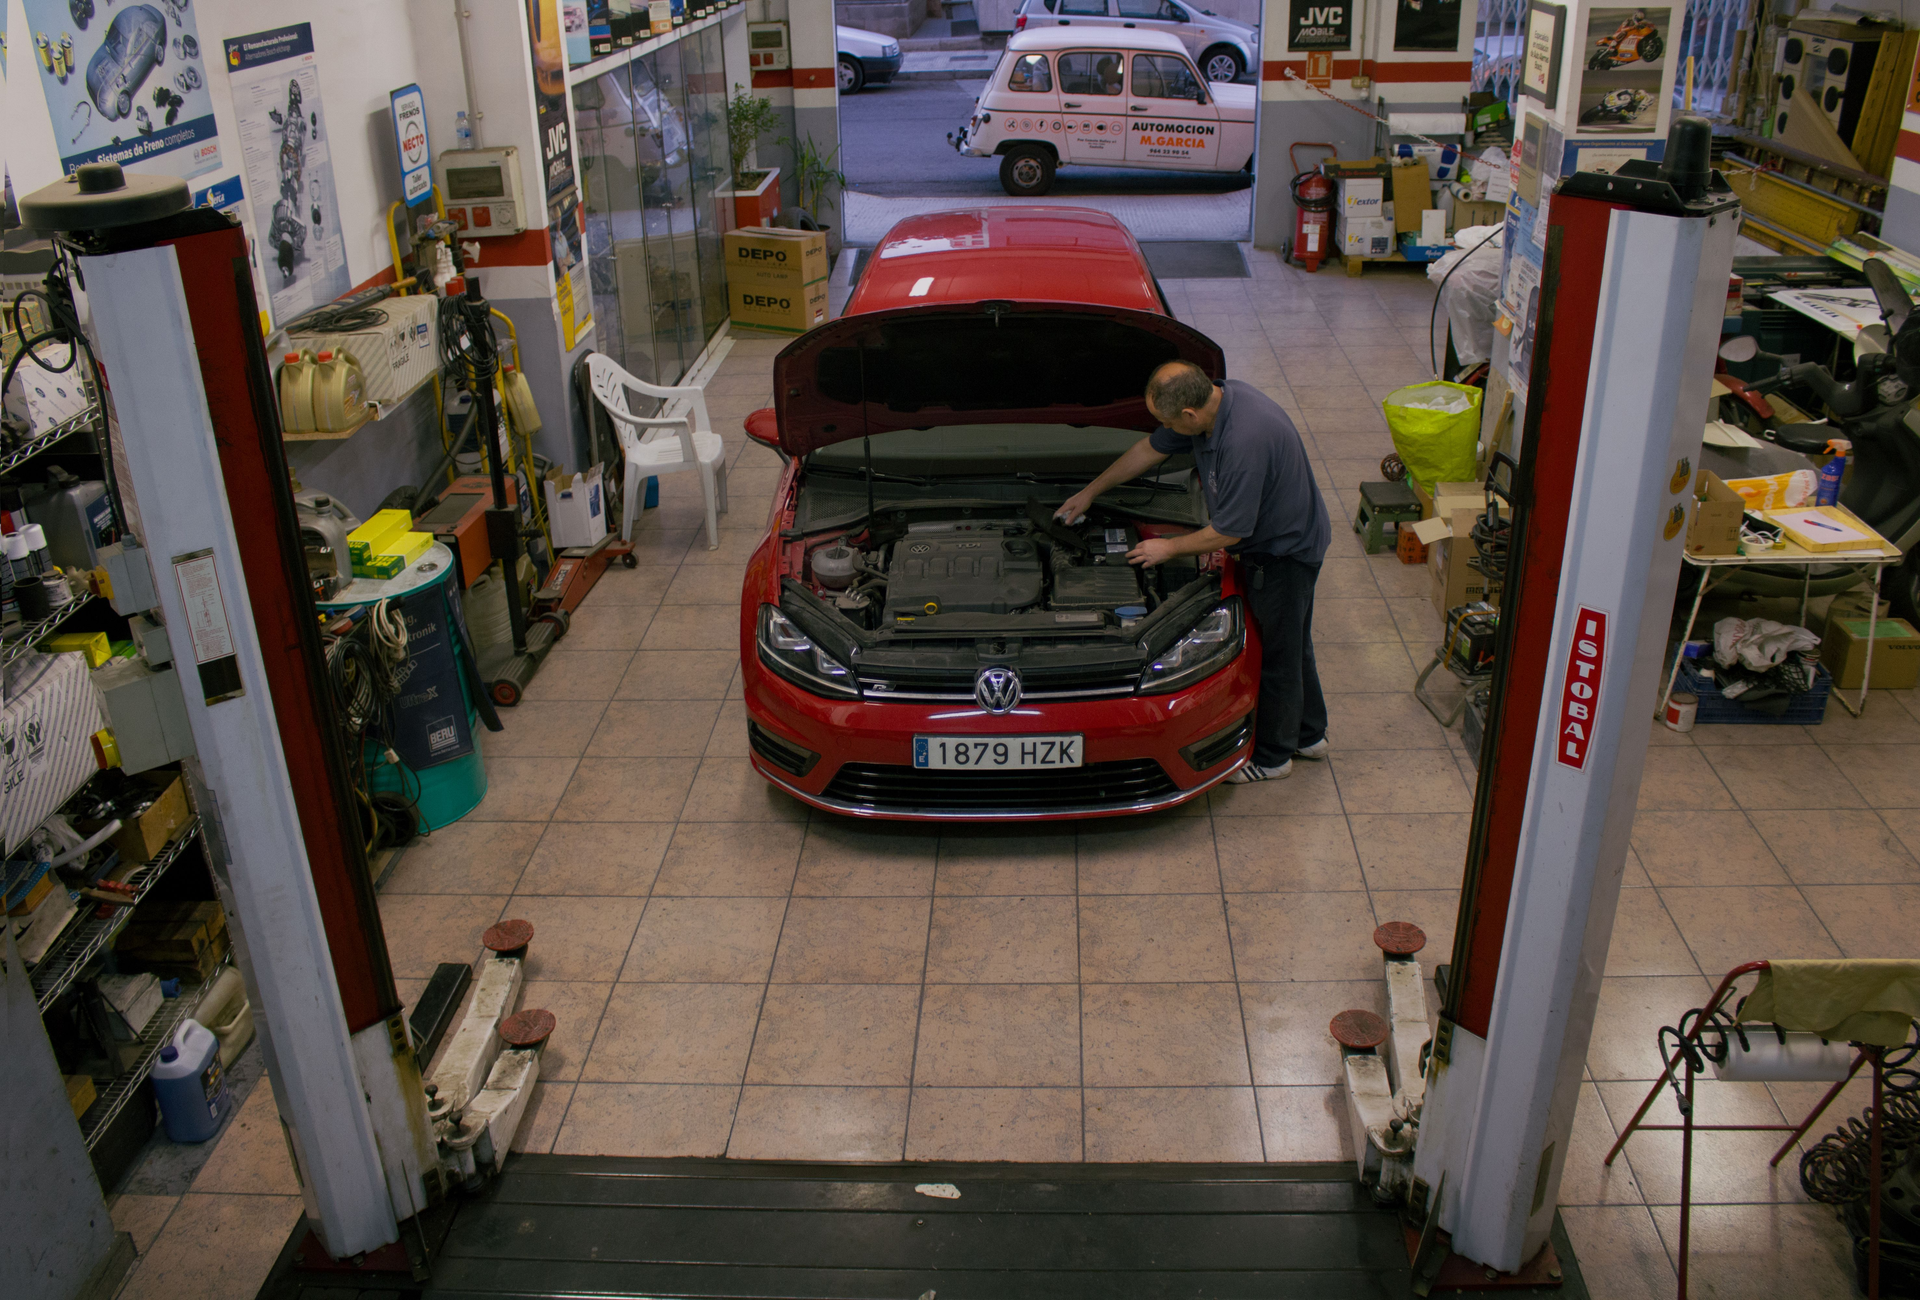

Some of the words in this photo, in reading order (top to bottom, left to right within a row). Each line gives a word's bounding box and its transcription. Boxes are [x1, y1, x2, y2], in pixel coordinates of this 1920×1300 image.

[1300, 6, 1343, 25] JVC
[399, 106, 420, 121] FRENOS
[1132, 122, 1214, 135] AUTOMOCION
[97, 148, 133, 164] Sistemas
[133, 144, 143, 156] de
[144, 138, 164, 154] Freno
[164, 128, 195, 146] completos
[402, 133, 424, 153] NECTO
[546, 122, 568, 160] JVC
[1140, 135, 1205, 148] M.GARCIA
[201, 145, 217, 157] BOSCH
[412, 173, 422, 184] Taller
[738, 247, 786, 262] DEPO
[806, 246, 822, 257] DEPO
[743, 294, 791, 309] DEPO
[810, 294, 825, 304] DEPO
[408, 622, 437, 642] tronik
[1564, 619, 1598, 759] ISTOBAL
[430, 725, 454, 744] BERU
[939, 742, 1008, 765] 1879
[1021, 740, 1075, 764] HZK
[4, 769, 25, 794] GILE
